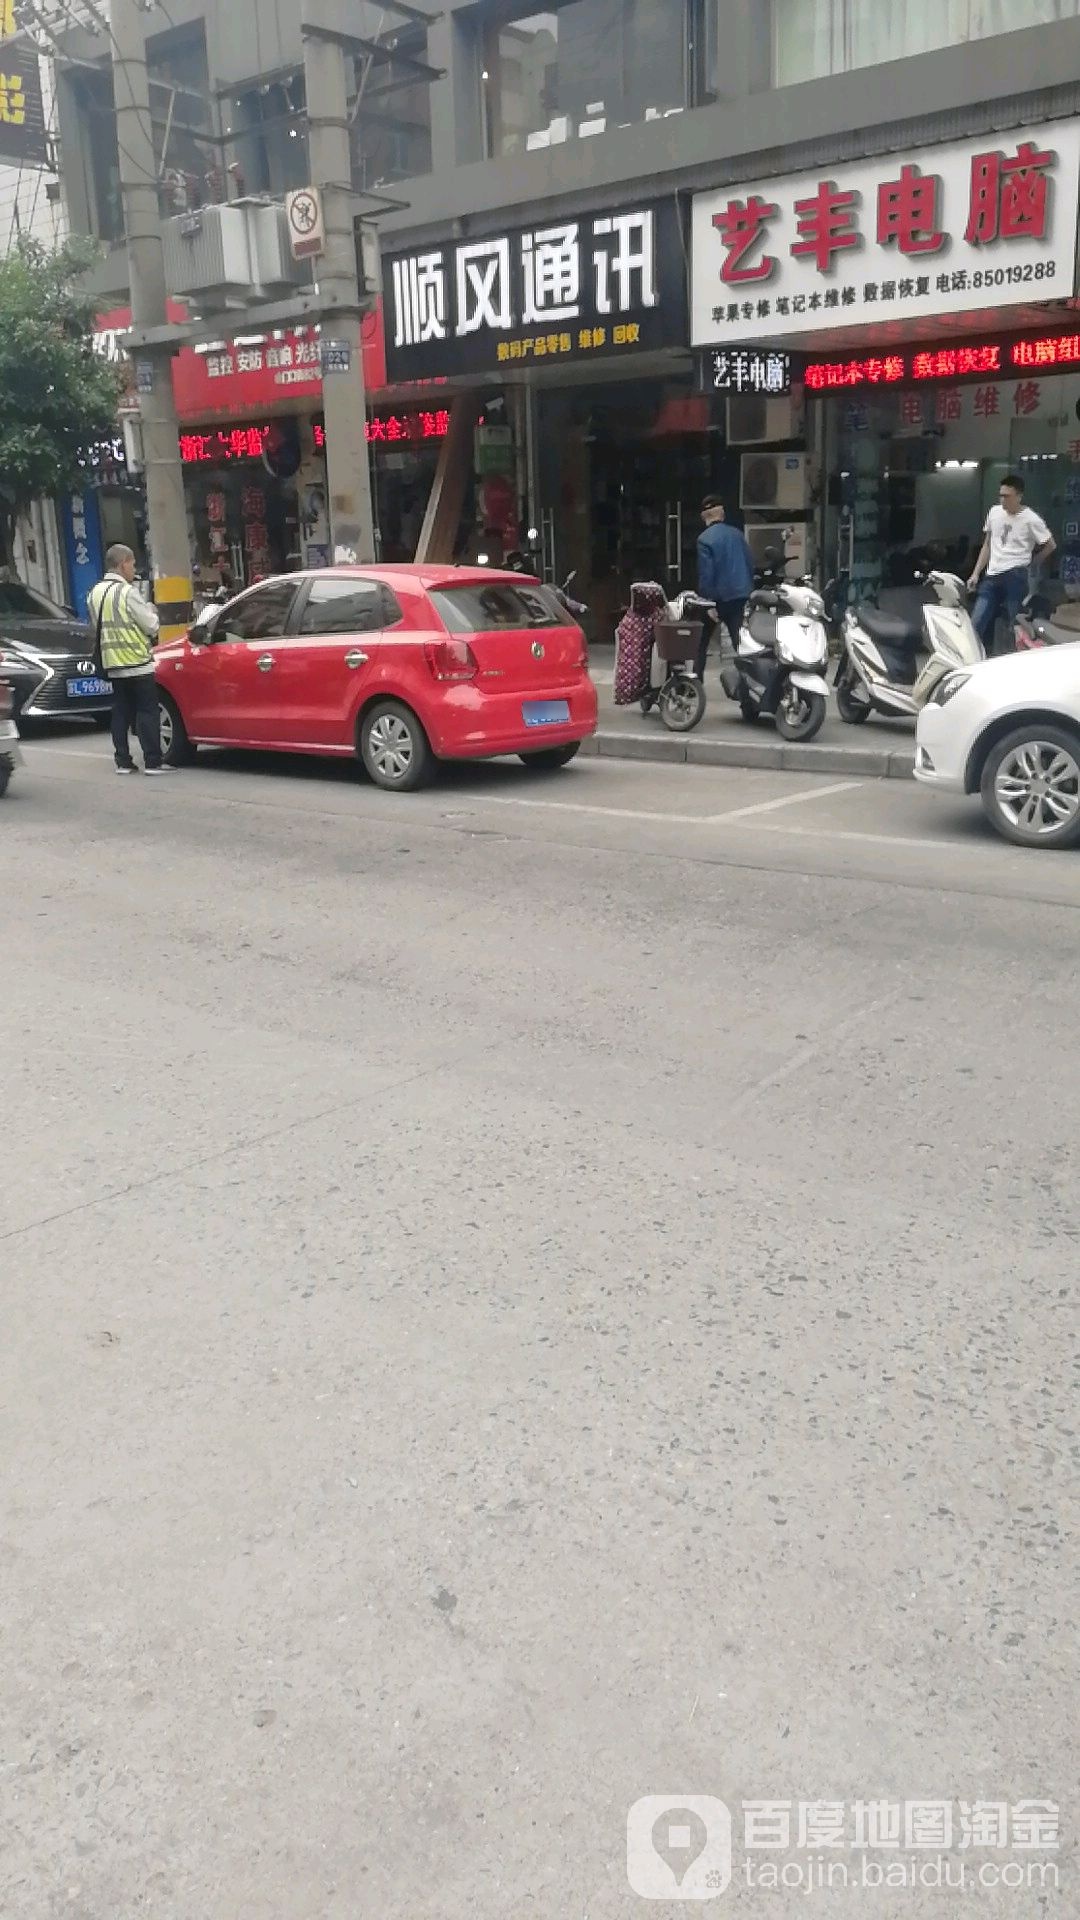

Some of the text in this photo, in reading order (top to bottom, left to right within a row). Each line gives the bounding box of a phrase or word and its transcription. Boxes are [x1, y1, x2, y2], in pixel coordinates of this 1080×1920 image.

[711, 141, 1055, 283] 艺丰电脑
[392, 210, 656, 347] 顺风通讯
[712, 260, 1056, 324] 苹果专修 笔记本维修 数据恢复 电话:85019288
[237, 350, 262, 372] 安防
[579, 327, 605, 348] 维修
[613, 323, 640, 344] 回收
[903, 381, 1041, 424] 电脑维修
